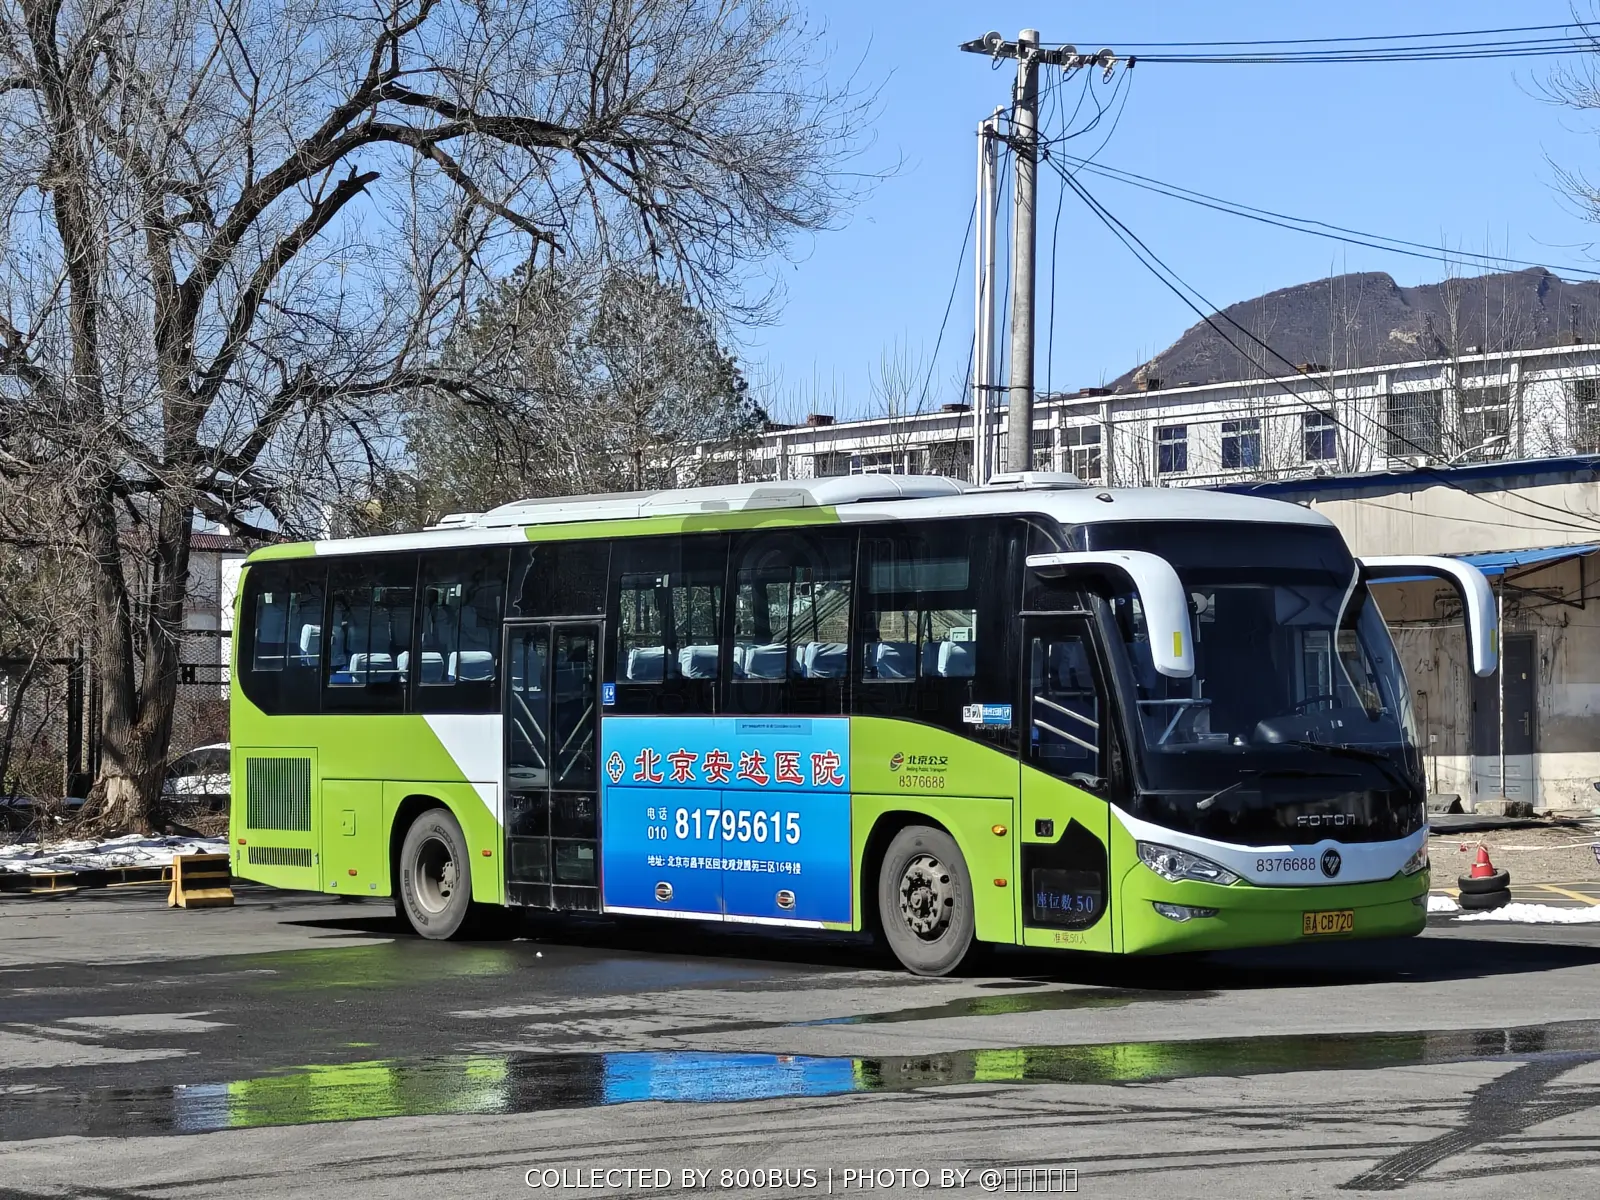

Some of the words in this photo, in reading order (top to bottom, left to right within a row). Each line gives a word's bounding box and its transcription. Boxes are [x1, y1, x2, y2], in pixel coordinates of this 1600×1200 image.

[633, 748, 845, 787] 北京安达医院
[907, 755, 948, 766] 北京公交
[899, 775, 945, 789] 8376688
[647, 807, 668, 821] 电话
[1297, 813, 1356, 827] FOTON
[647, 826, 668, 841] 010
[674, 807, 801, 845] 81795615
[1256, 857, 1316, 872] 8376688
[1036, 891, 1073, 911] 座位数
[1076, 895, 1094, 913] 50
